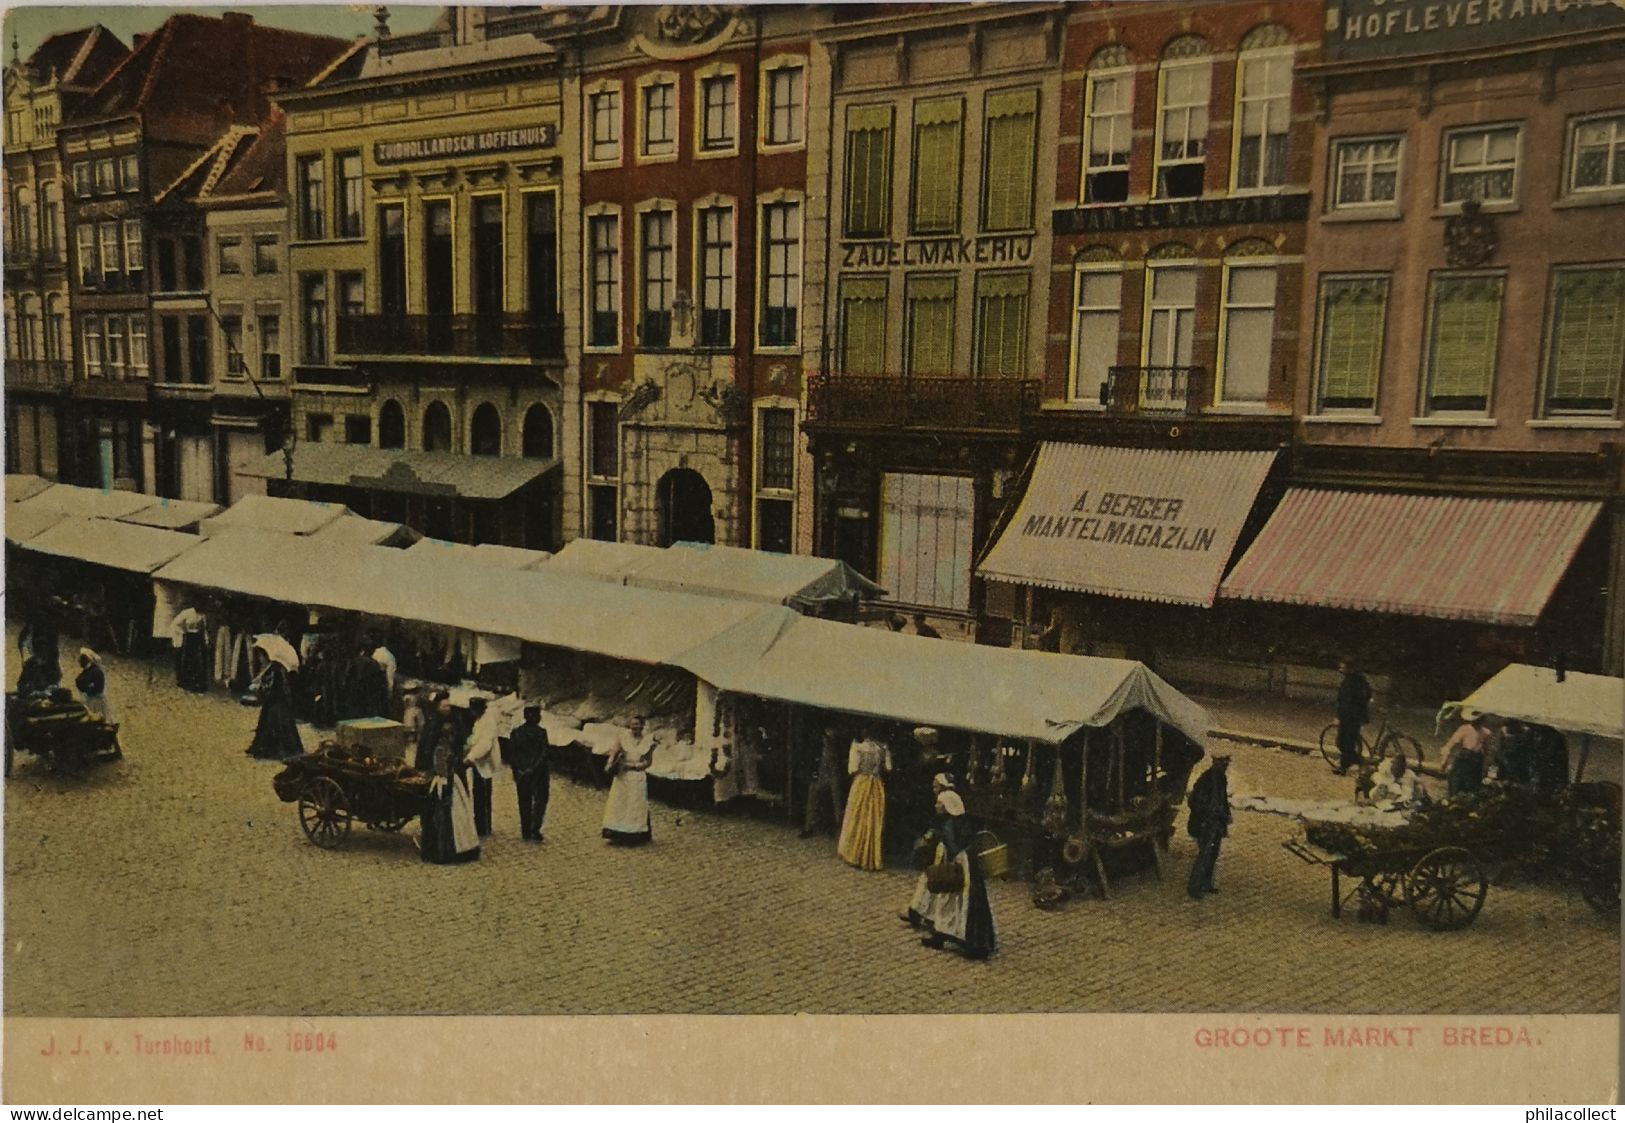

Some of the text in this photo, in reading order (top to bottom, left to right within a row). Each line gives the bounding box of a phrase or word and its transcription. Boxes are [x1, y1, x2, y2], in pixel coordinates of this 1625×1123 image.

[1345, 0, 1608, 40] HOFLEVERAN
[379, 126, 548, 160] ZUIDHOLLANDSCH KOFFIEHUIS
[842, 237, 1033, 267] ZADELMAKERIJ
[1071, 490, 1184, 522] A. BERGER
[1022, 514, 1217, 552] MANTELMAGAZIJN
